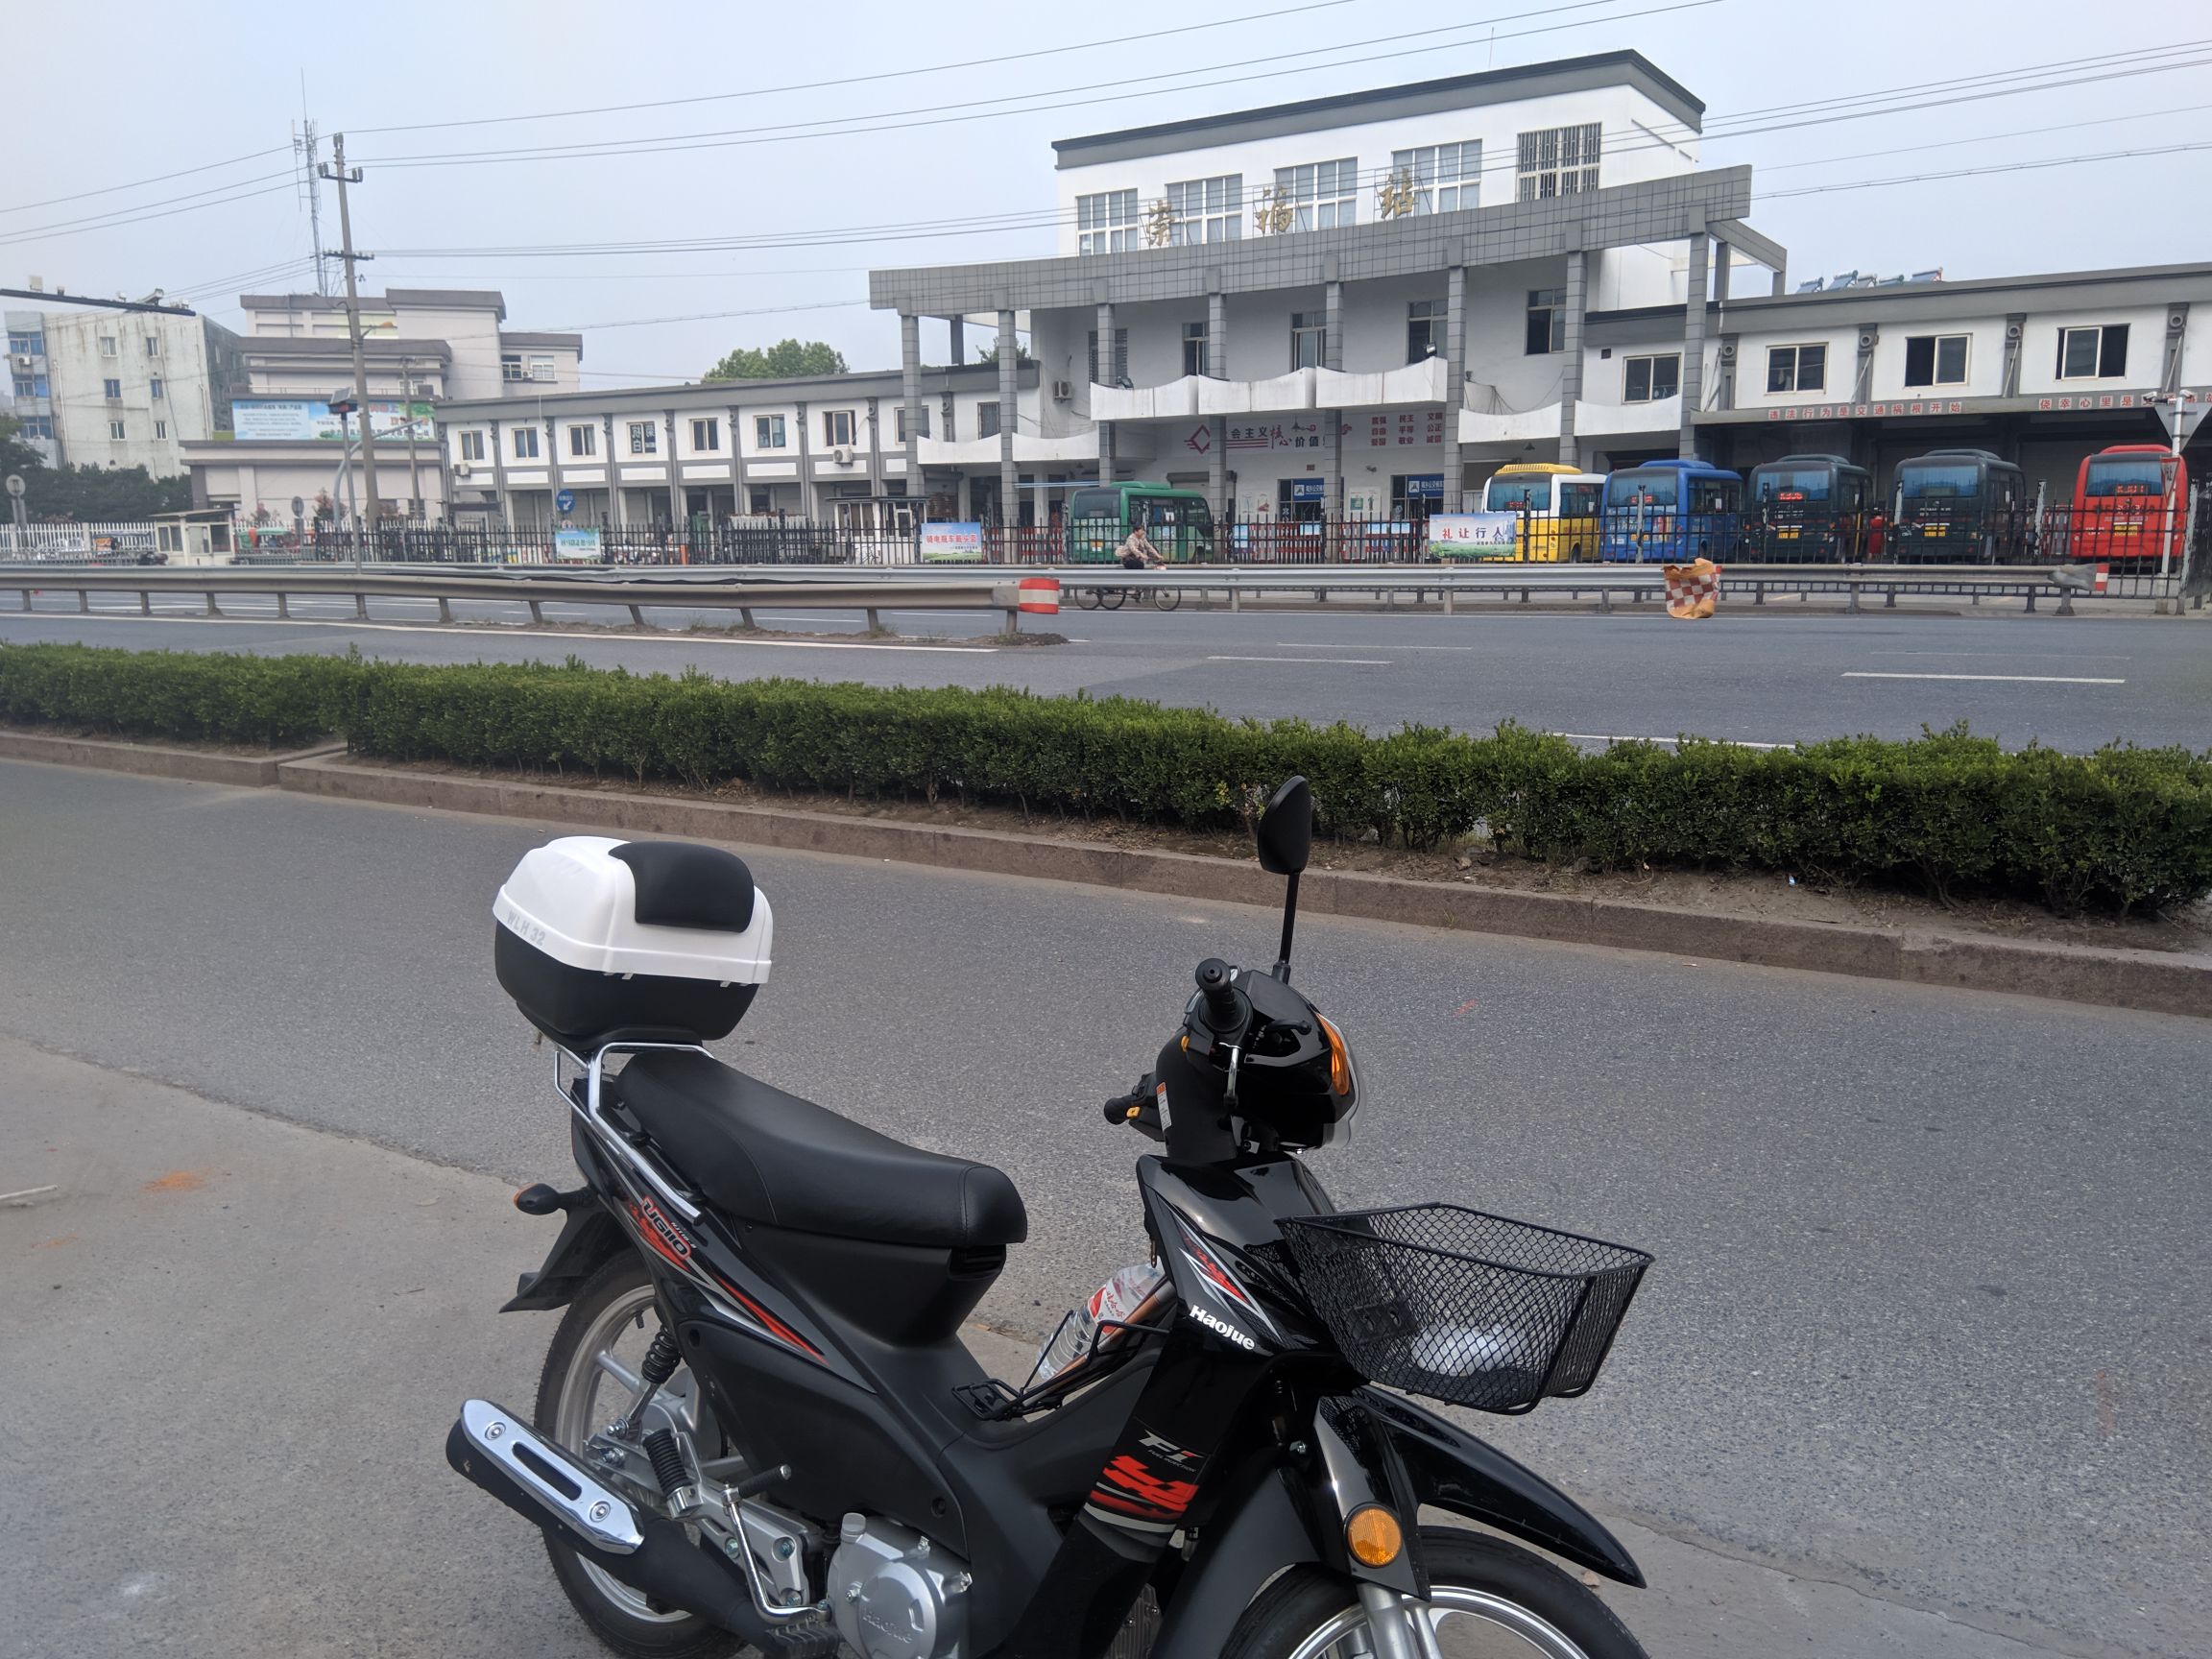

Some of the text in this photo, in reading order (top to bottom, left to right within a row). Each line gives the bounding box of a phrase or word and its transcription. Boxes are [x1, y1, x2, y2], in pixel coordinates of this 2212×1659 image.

[1146, 167, 1414, 246] 崇福站
[1769, 402, 1961, 420] 违法行为是交通祸根开始
[1442, 526, 1503, 539] 礼让行人
[530, 926, 546, 946] 32
[1189, 1304, 1255, 1351] Haojue
